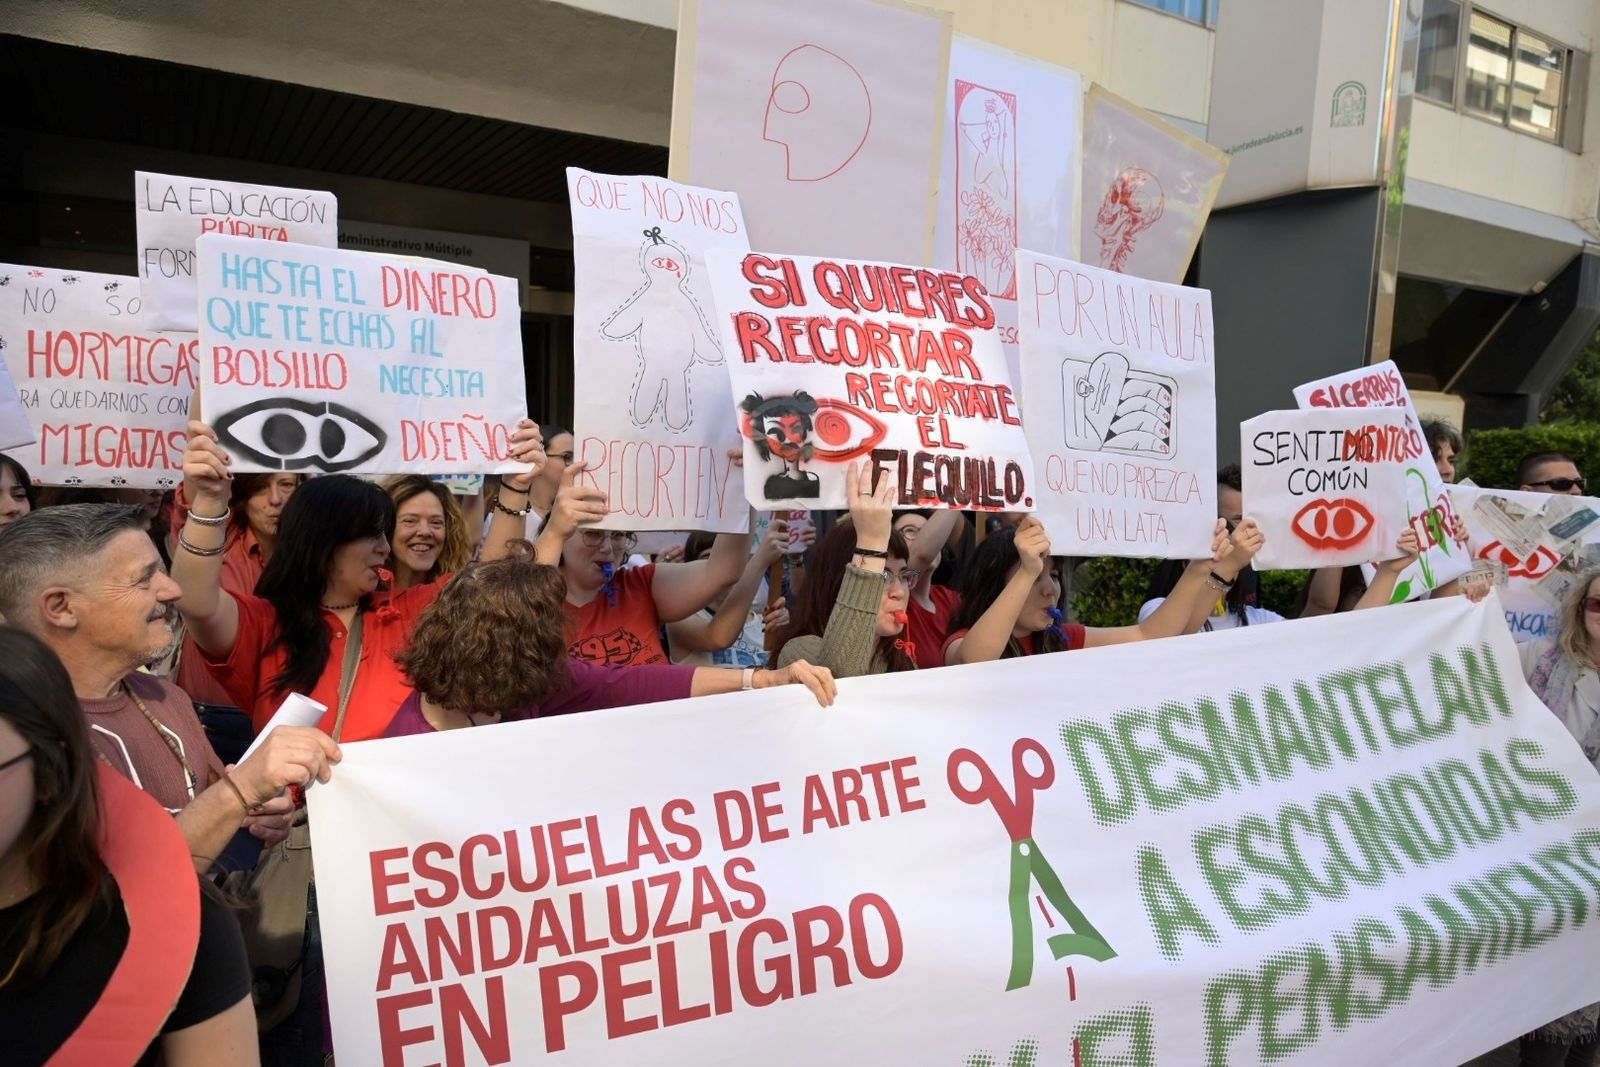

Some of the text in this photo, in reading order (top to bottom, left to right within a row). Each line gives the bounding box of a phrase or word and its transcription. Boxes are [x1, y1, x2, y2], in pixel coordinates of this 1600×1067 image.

[146, 179, 326, 225] LA EDUCACIÓN
[577, 175, 738, 234] QUE NO NOS
[338, 232, 473, 258] dministrativo Múltiple
[23, 287, 56, 315] NO
[221, 252, 497, 319] HASTA EL DINERO
[741, 253, 996, 330] SI QUIERES
[1035, 263, 1207, 363] POR UN AULA
[206, 297, 443, 358] QUE TE ECHAS AL
[732, 311, 983, 381] RECORTAR
[211, 345, 485, 398] BOLSILLO NECESITA
[845, 372, 1022, 427] RECORTATE
[20, 389, 189, 417] RA QUEDARNOS CON
[40, 423, 188, 470] MIGAJAS
[401, 413, 511, 462] DISEÑO
[916, 416, 967, 449] EL
[581, 436, 734, 521] RECORTEN
[1046, 454, 1202, 505] QUE NO PAREZCA
[1288, 466, 1367, 496] COMÚN
[1076, 507, 1169, 544] UNA LATA
[1059, 642, 1512, 828] DESMANTELAN
[369, 755, 926, 916] ESCUELAS DE ARTE
[1134, 738, 1580, 965] A ESCONDIDAS
[375, 857, 766, 991] ANDALUZAS
[376, 892, 904, 1067] EN PELIGRO
